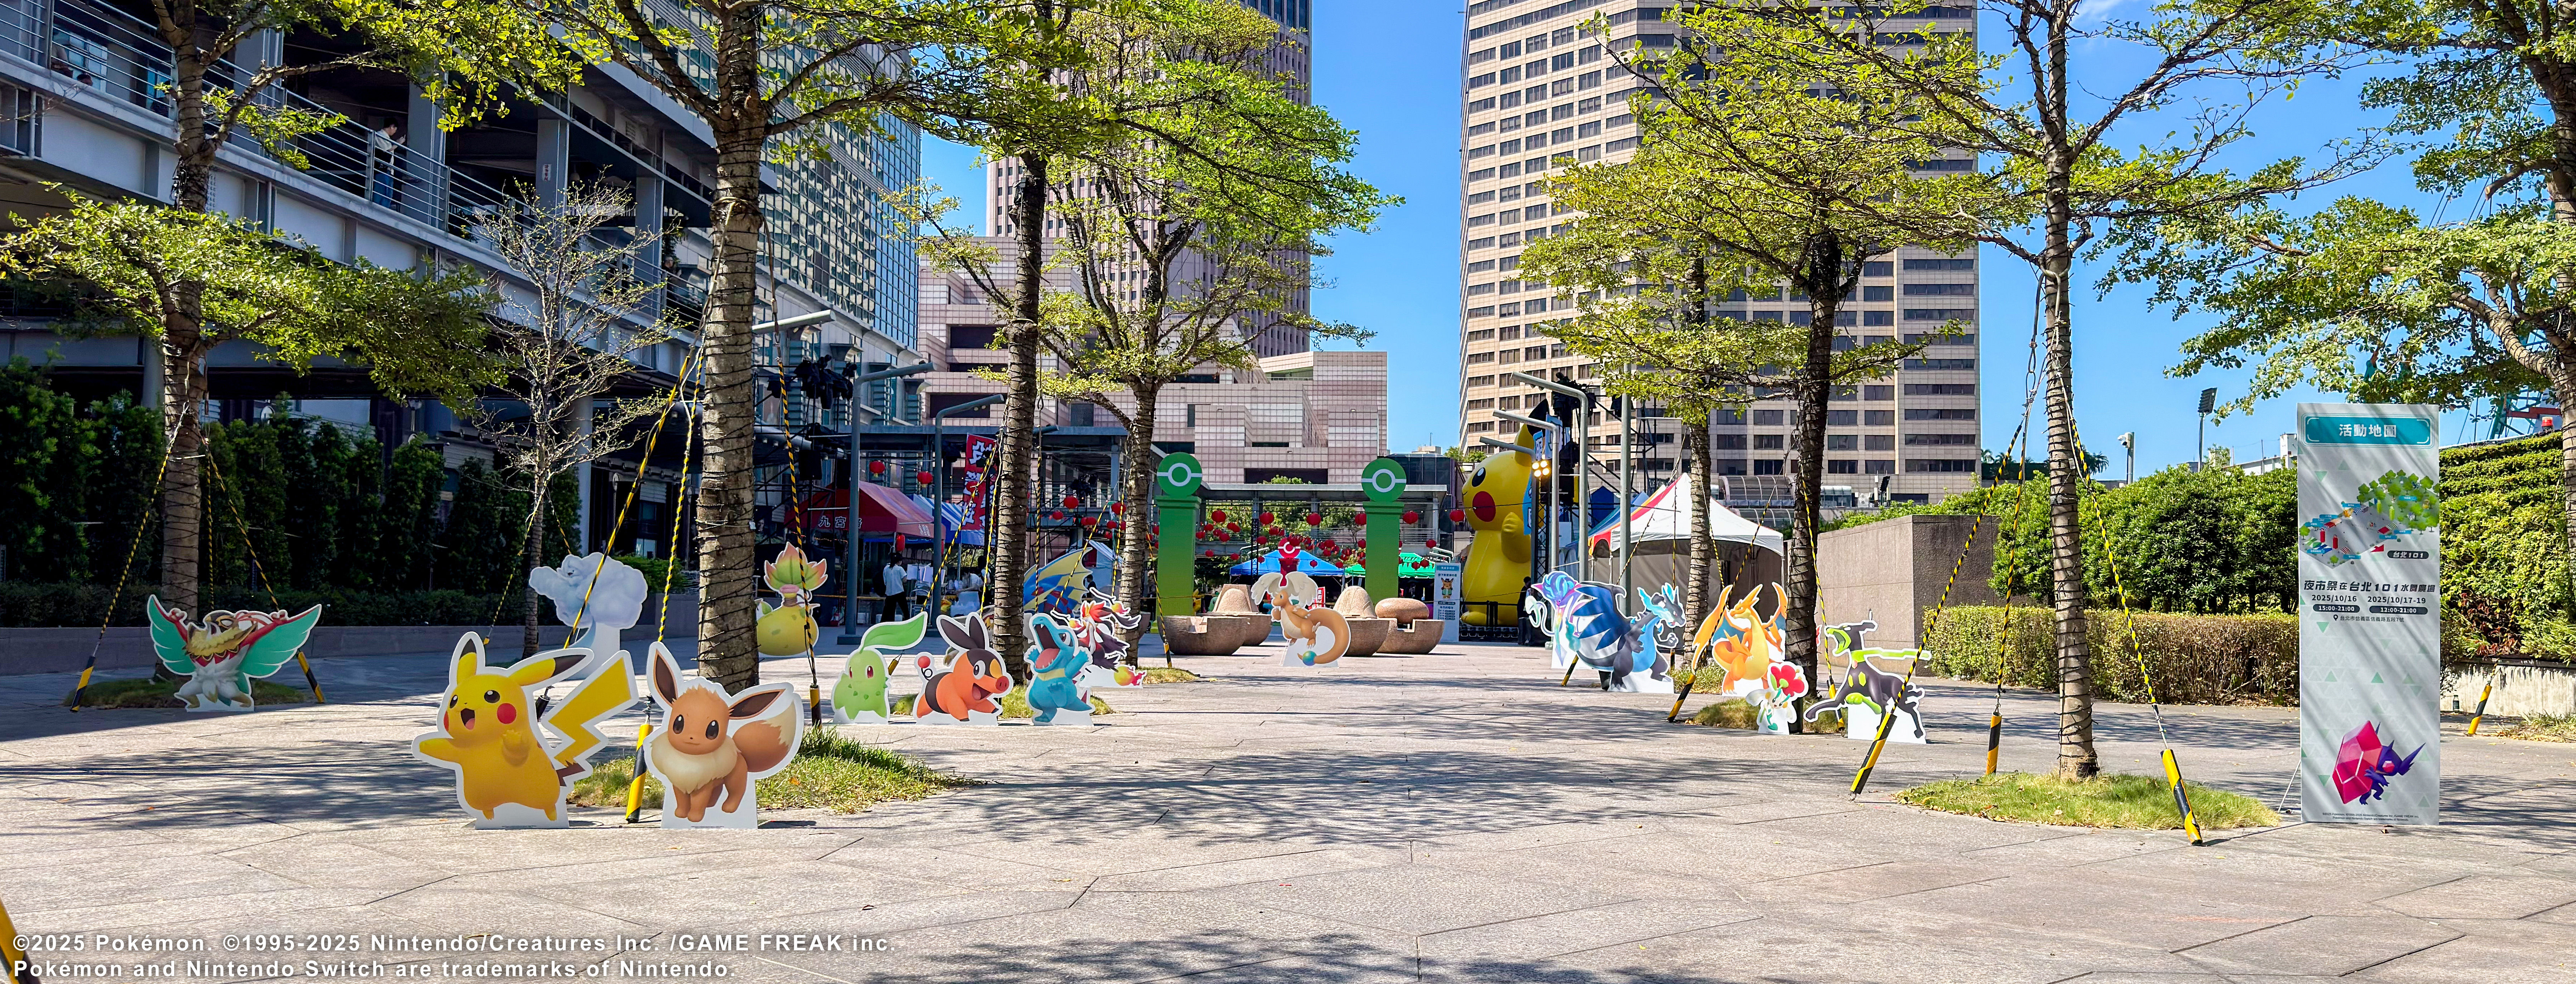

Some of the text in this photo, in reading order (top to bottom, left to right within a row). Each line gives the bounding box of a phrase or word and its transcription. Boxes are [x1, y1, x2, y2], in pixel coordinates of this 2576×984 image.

[2339, 424, 2396, 437] 活動地圖
[2367, 596, 2426, 604] 2025/10/17-19
